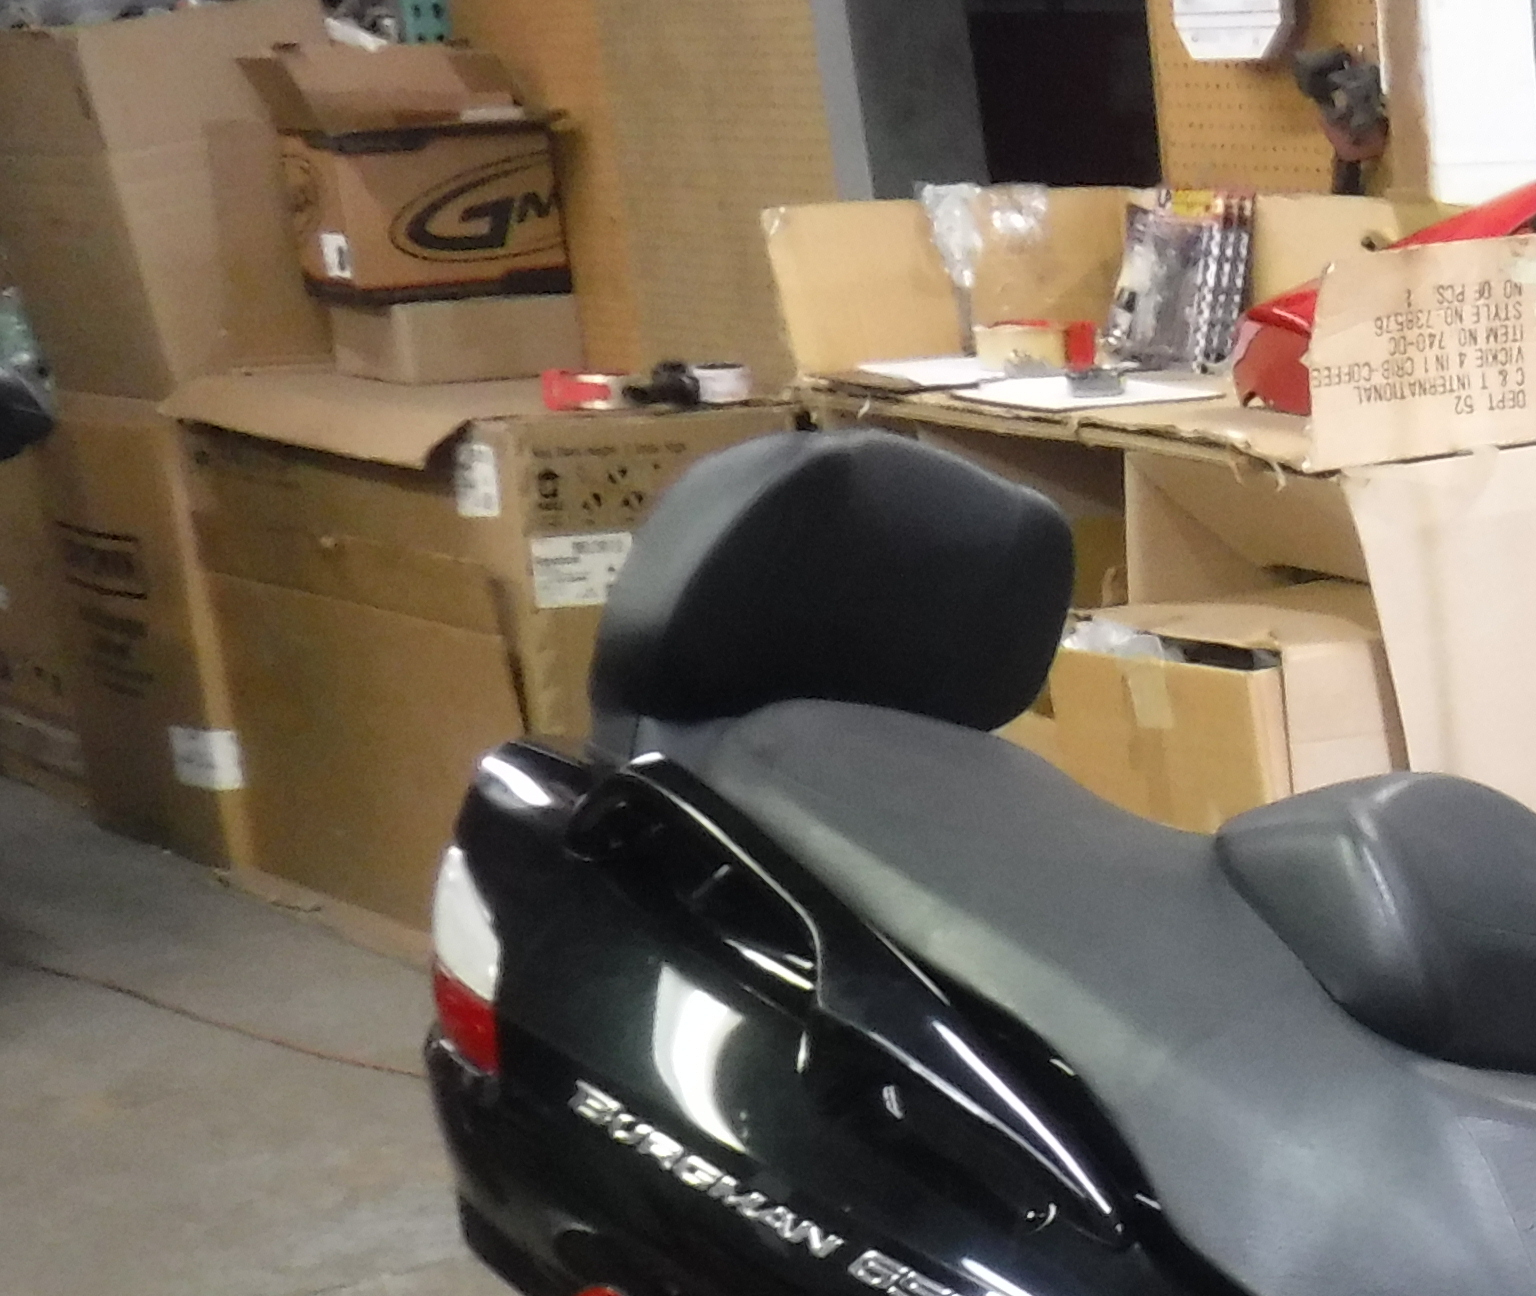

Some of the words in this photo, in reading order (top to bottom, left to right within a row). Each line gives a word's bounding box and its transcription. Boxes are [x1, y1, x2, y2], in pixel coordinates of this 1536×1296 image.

[1470, 301, 1522, 325] STYLE
[1484, 324, 1523, 345] ITEM
[1435, 354, 1450, 371] IN
[1475, 346, 1524, 368] VICKIE
[1480, 372, 1488, 390] T
[1498, 370, 1508, 387] &
[1516, 367, 1525, 387] C
[1353, 373, 1471, 405] INTERNATIONAL
[1454, 394, 1474, 414] 52
[1487, 389, 1526, 411] DEPT
[572, 1080, 845, 1258] BURGMAN
